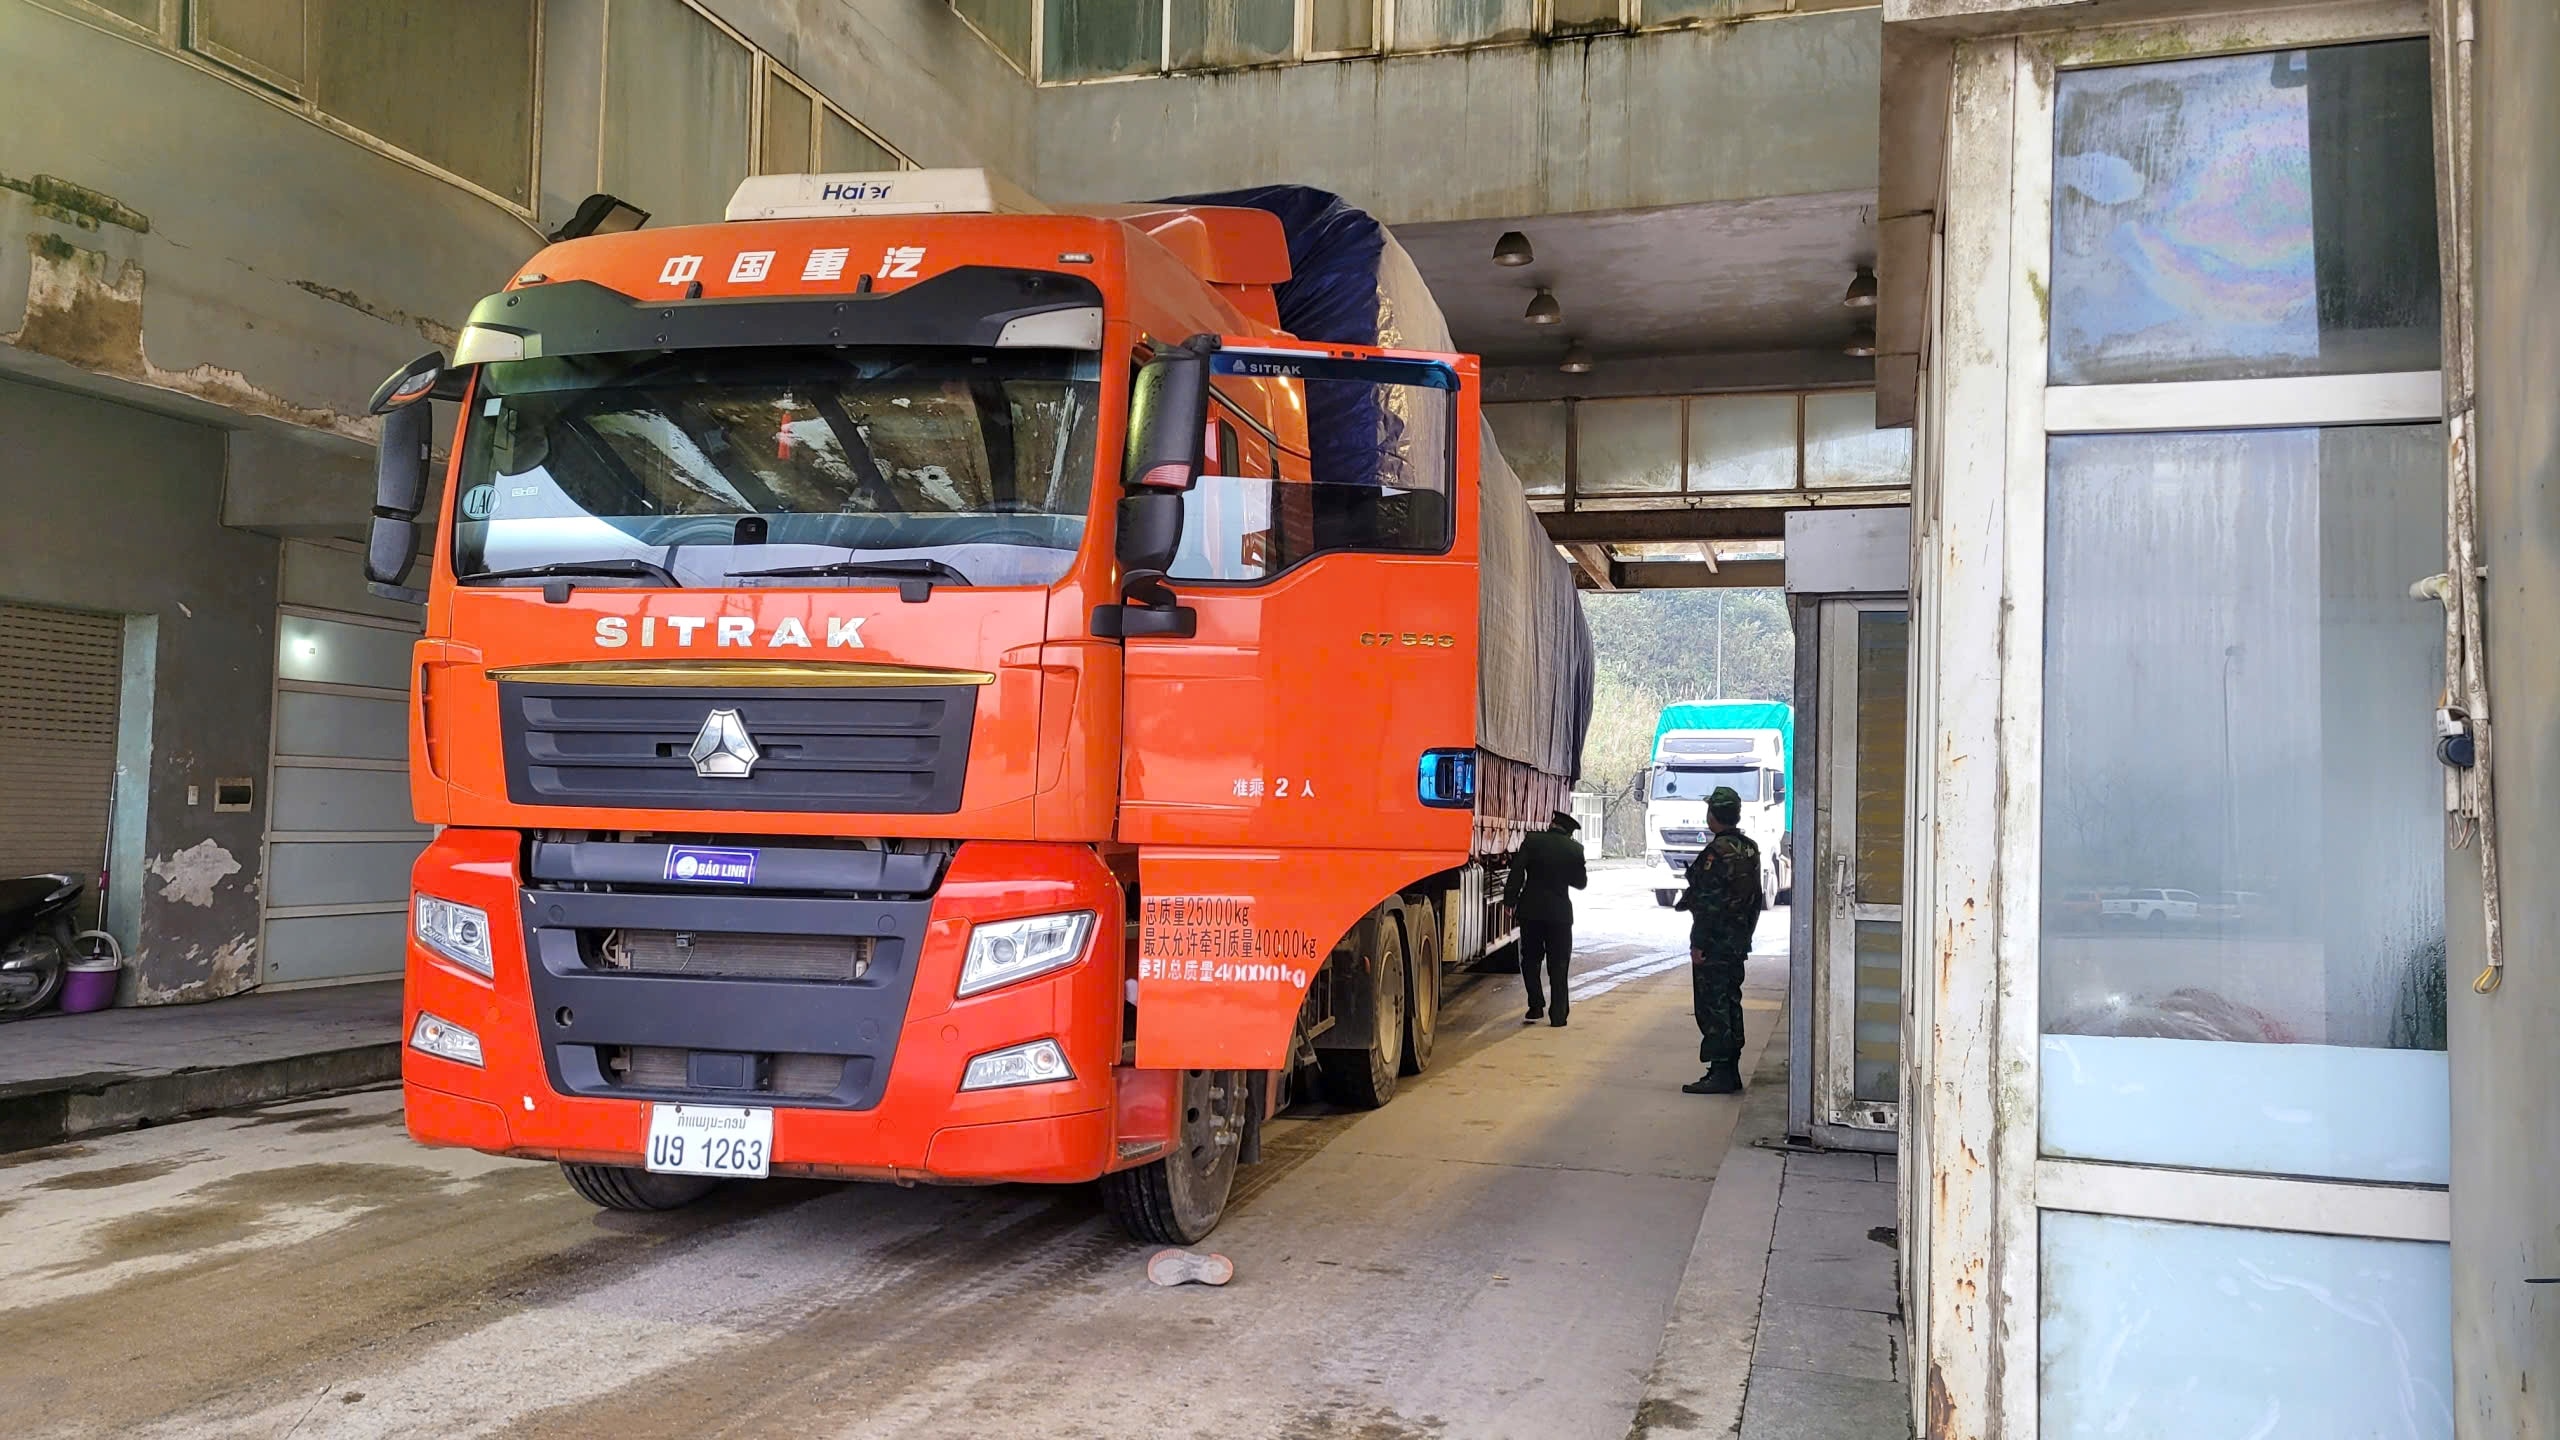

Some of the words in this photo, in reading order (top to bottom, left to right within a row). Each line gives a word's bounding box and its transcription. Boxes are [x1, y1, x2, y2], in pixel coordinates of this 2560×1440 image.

[822, 182, 891, 200] Haier
[659, 247, 926, 285] 中国重汽
[1249, 363, 1301, 375] SITRAK
[594, 616, 867, 648] SITRAK
[1360, 632, 1394, 646] C7
[1232, 778, 1265, 798] 准乘
[1275, 777, 1289, 797] 2
[1300, 779, 1315, 798] 人
[721, 864, 747, 878] LINH
[1145, 897, 1249, 927] 总质量25000kg
[1143, 927, 1317, 959] 最大允许牵引质量40000kg
[701, 1137, 763, 1170] 1263
